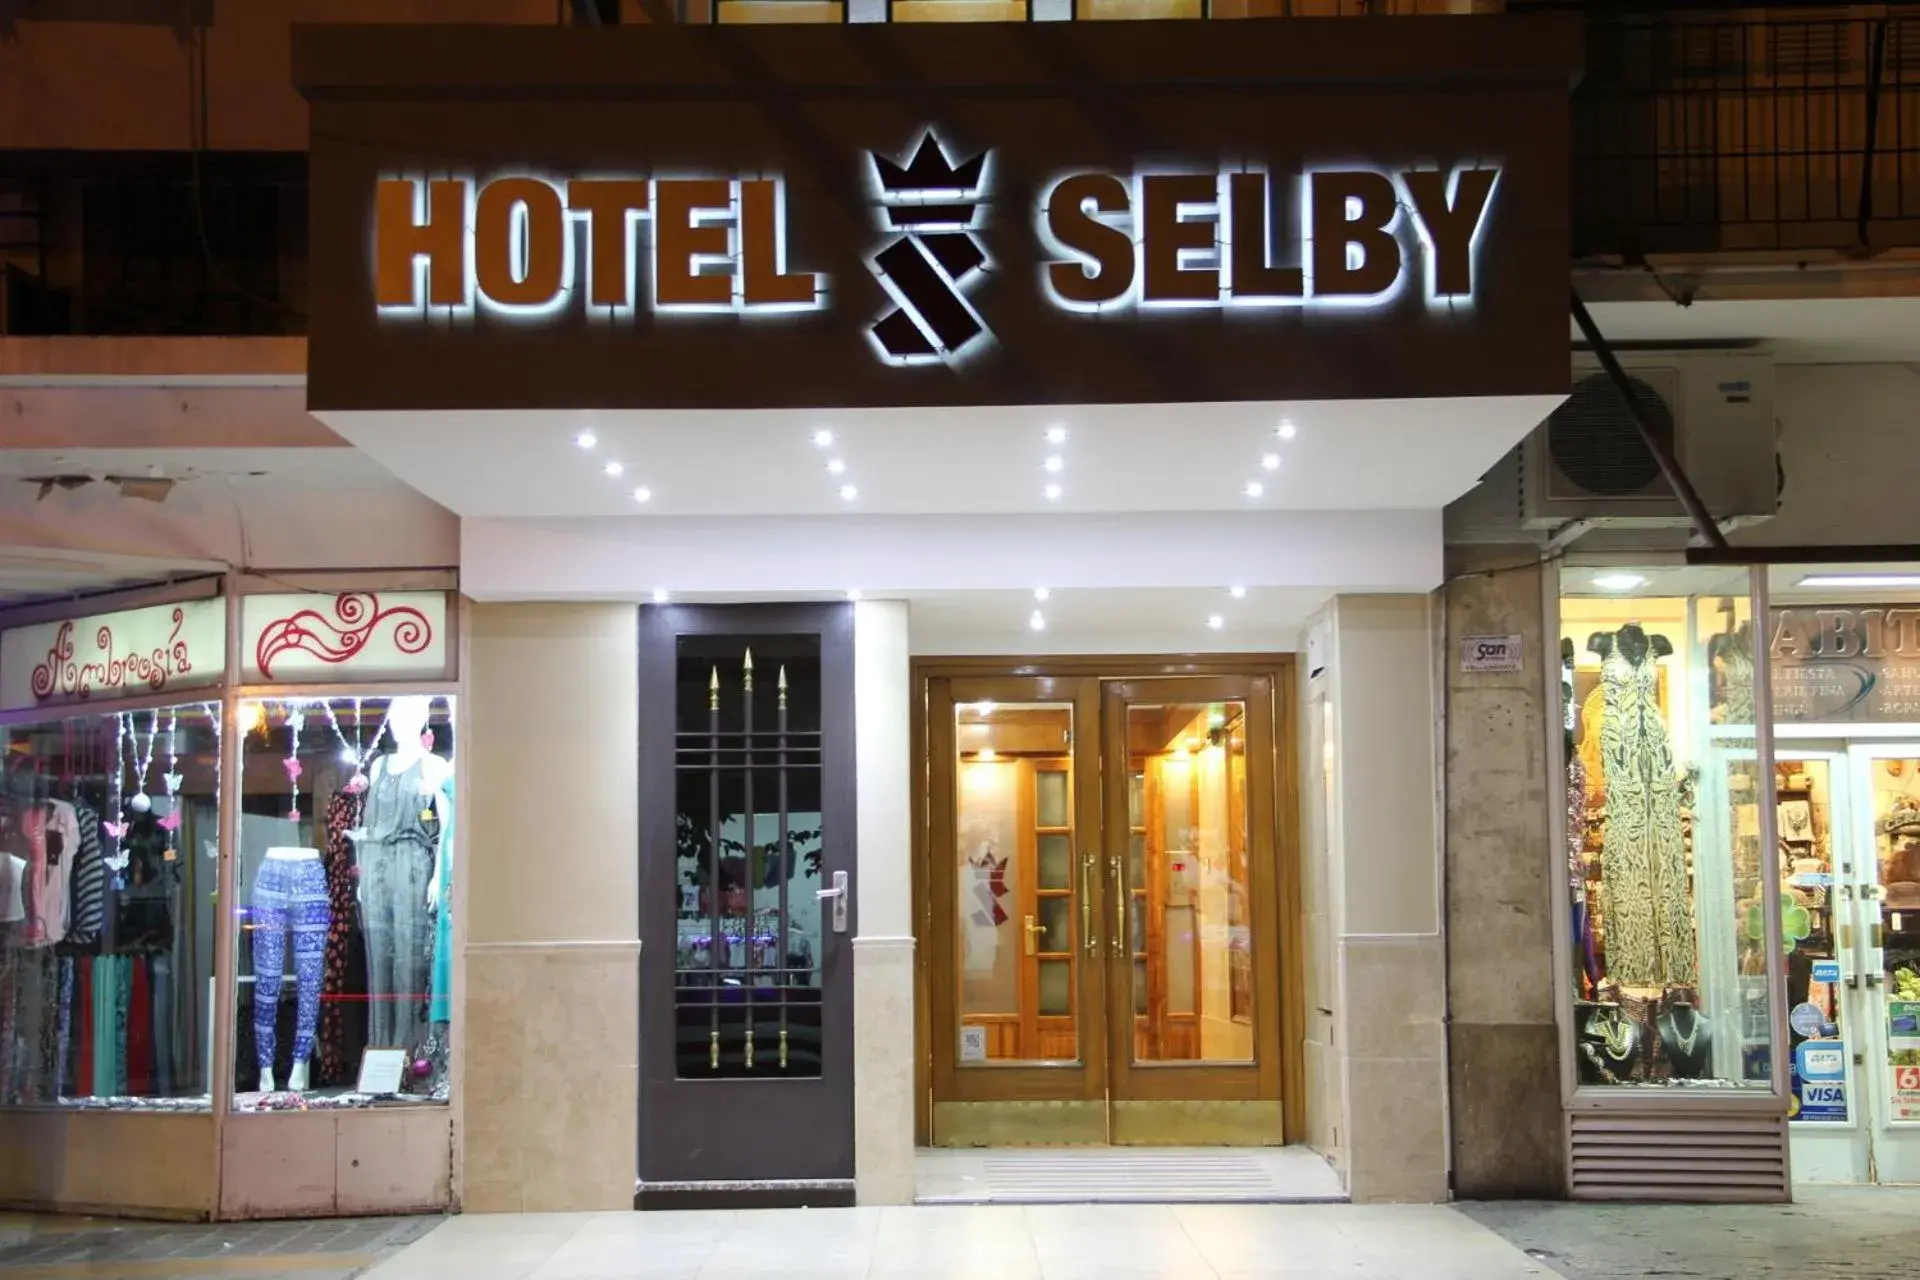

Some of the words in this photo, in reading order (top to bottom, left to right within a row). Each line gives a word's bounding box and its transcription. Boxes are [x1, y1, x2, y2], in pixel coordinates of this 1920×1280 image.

[376, 176, 818, 307] HOTEL
[1045, 169, 1501, 305] SELBY
[1807, 1087, 1844, 1102] VISA
